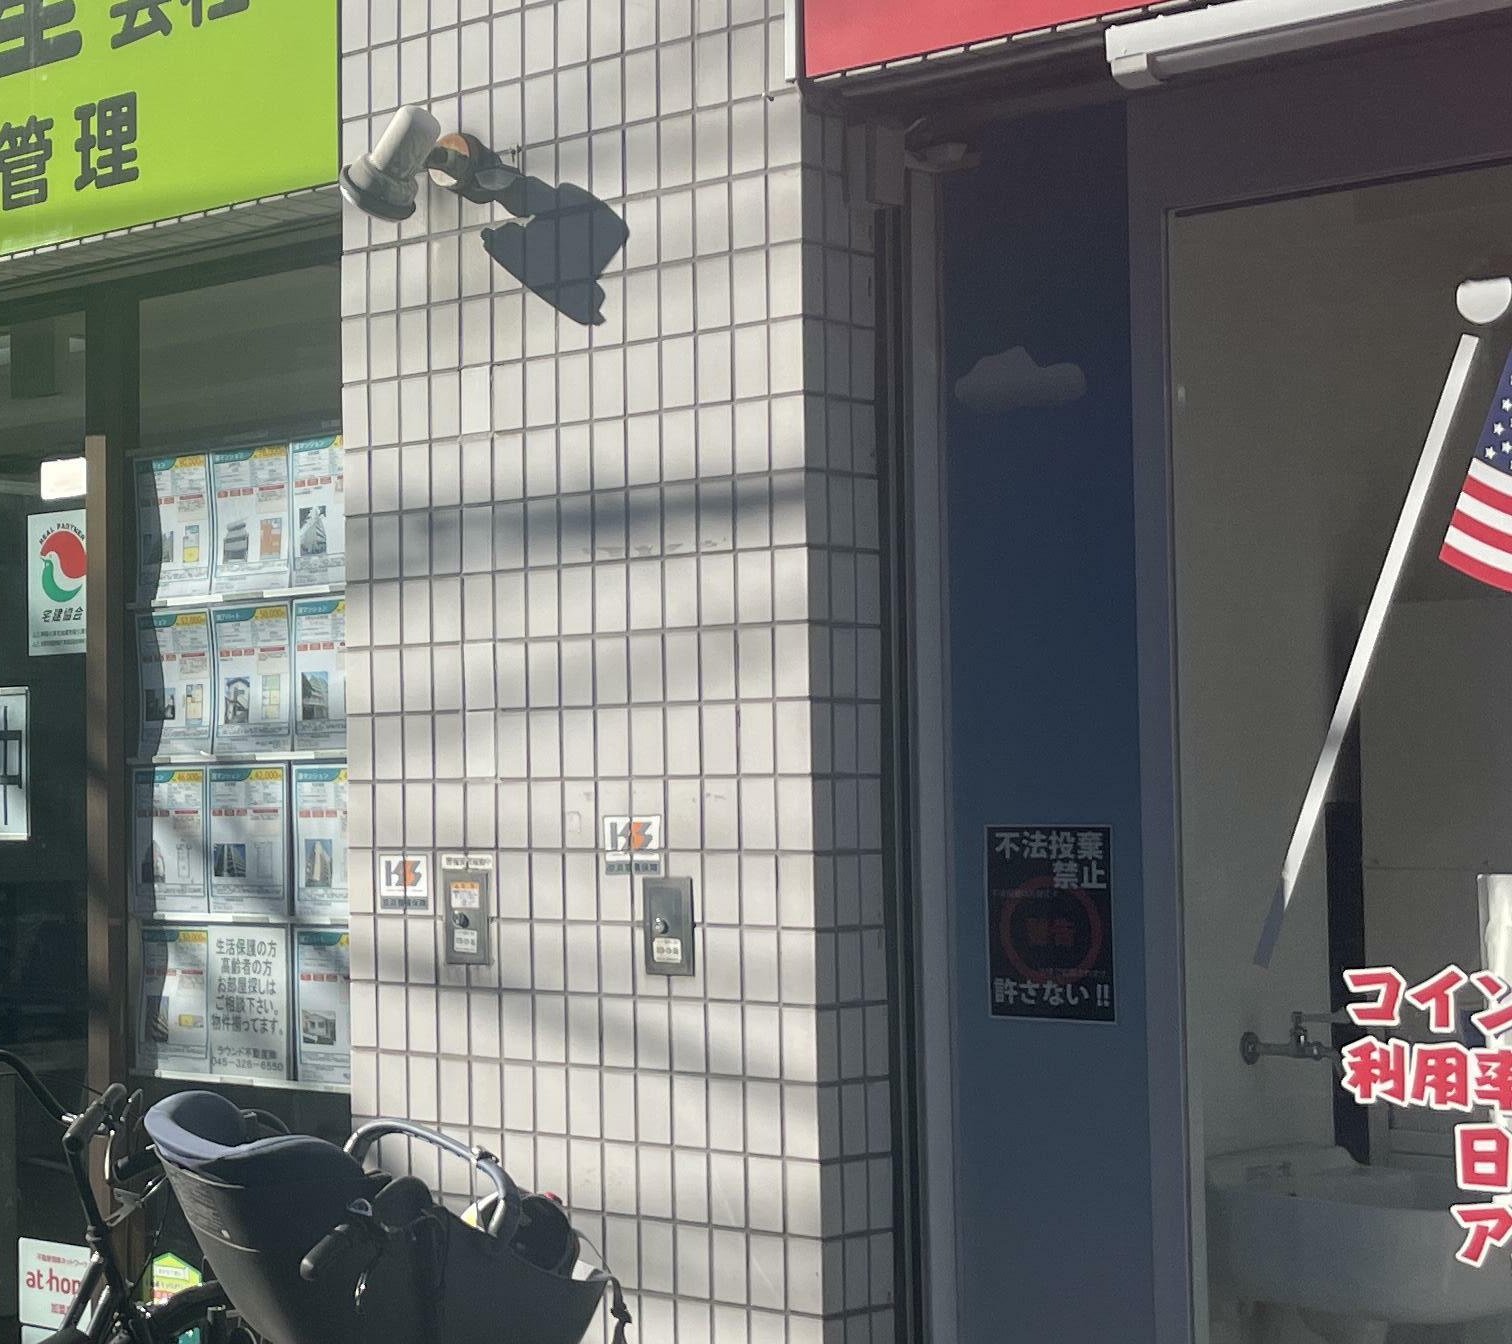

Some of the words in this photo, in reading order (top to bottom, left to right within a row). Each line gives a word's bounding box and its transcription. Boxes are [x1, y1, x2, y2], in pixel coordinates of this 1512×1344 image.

[995, 831, 1105, 861] 不法投棄
[1052, 861, 1107, 890] 禁止
